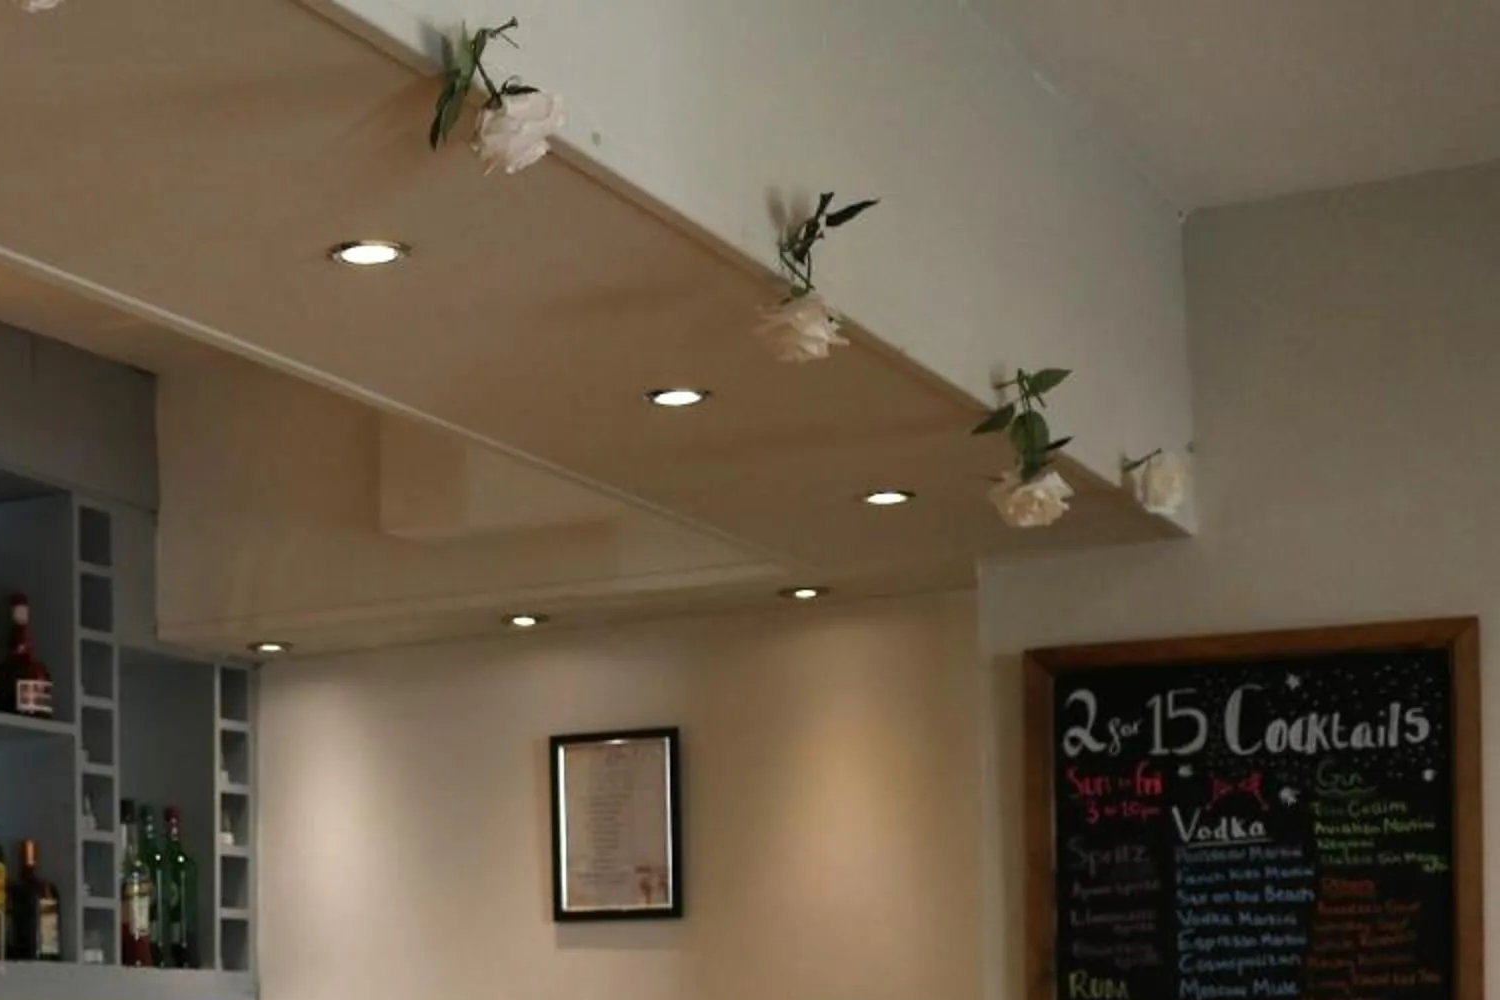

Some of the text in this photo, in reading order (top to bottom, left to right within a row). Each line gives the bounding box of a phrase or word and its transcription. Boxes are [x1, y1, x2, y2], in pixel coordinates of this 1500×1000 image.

[1063, 684, 1431, 758] 2 for 15 Cocktails
[1171, 804, 1268, 843] Vodka
